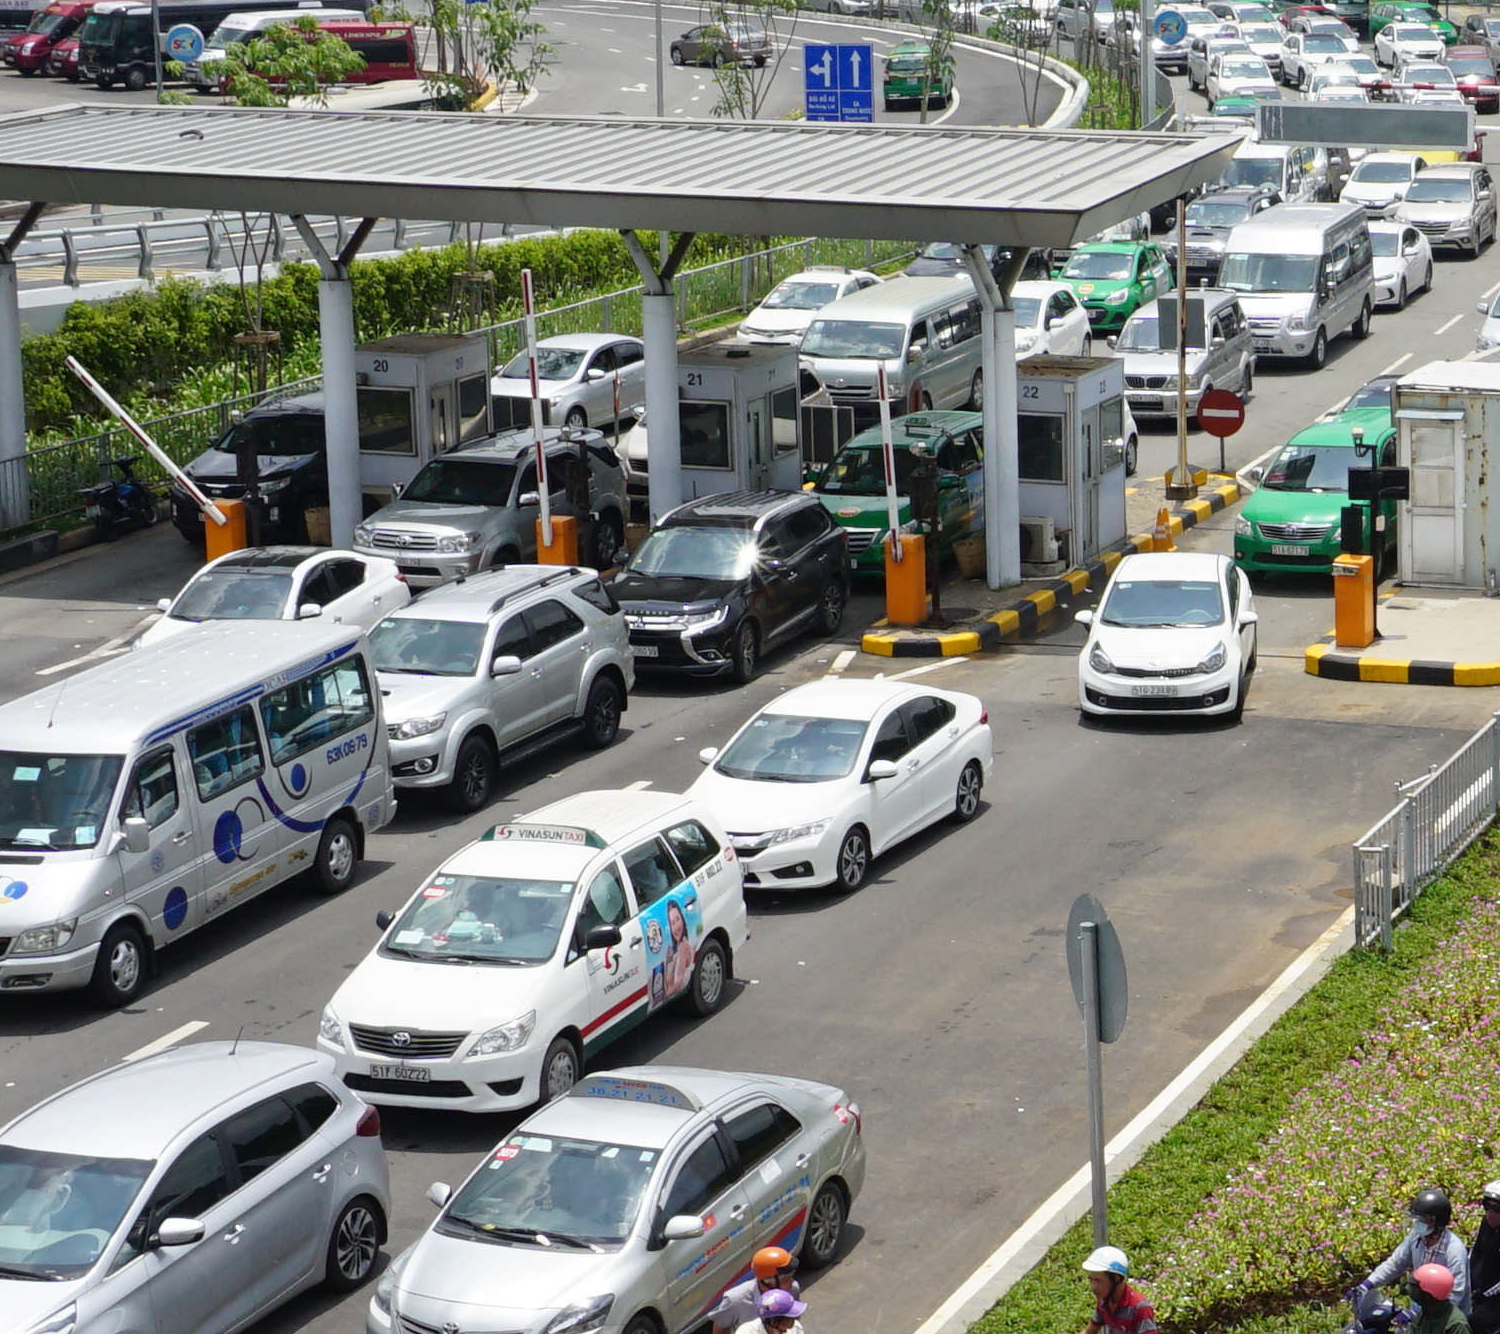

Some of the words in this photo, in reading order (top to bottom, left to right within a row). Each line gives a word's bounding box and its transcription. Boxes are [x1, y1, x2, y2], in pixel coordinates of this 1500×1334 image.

[373, 360, 389, 373] 20
[688, 374, 703, 387] 21
[1022, 386, 1039, 400] 22
